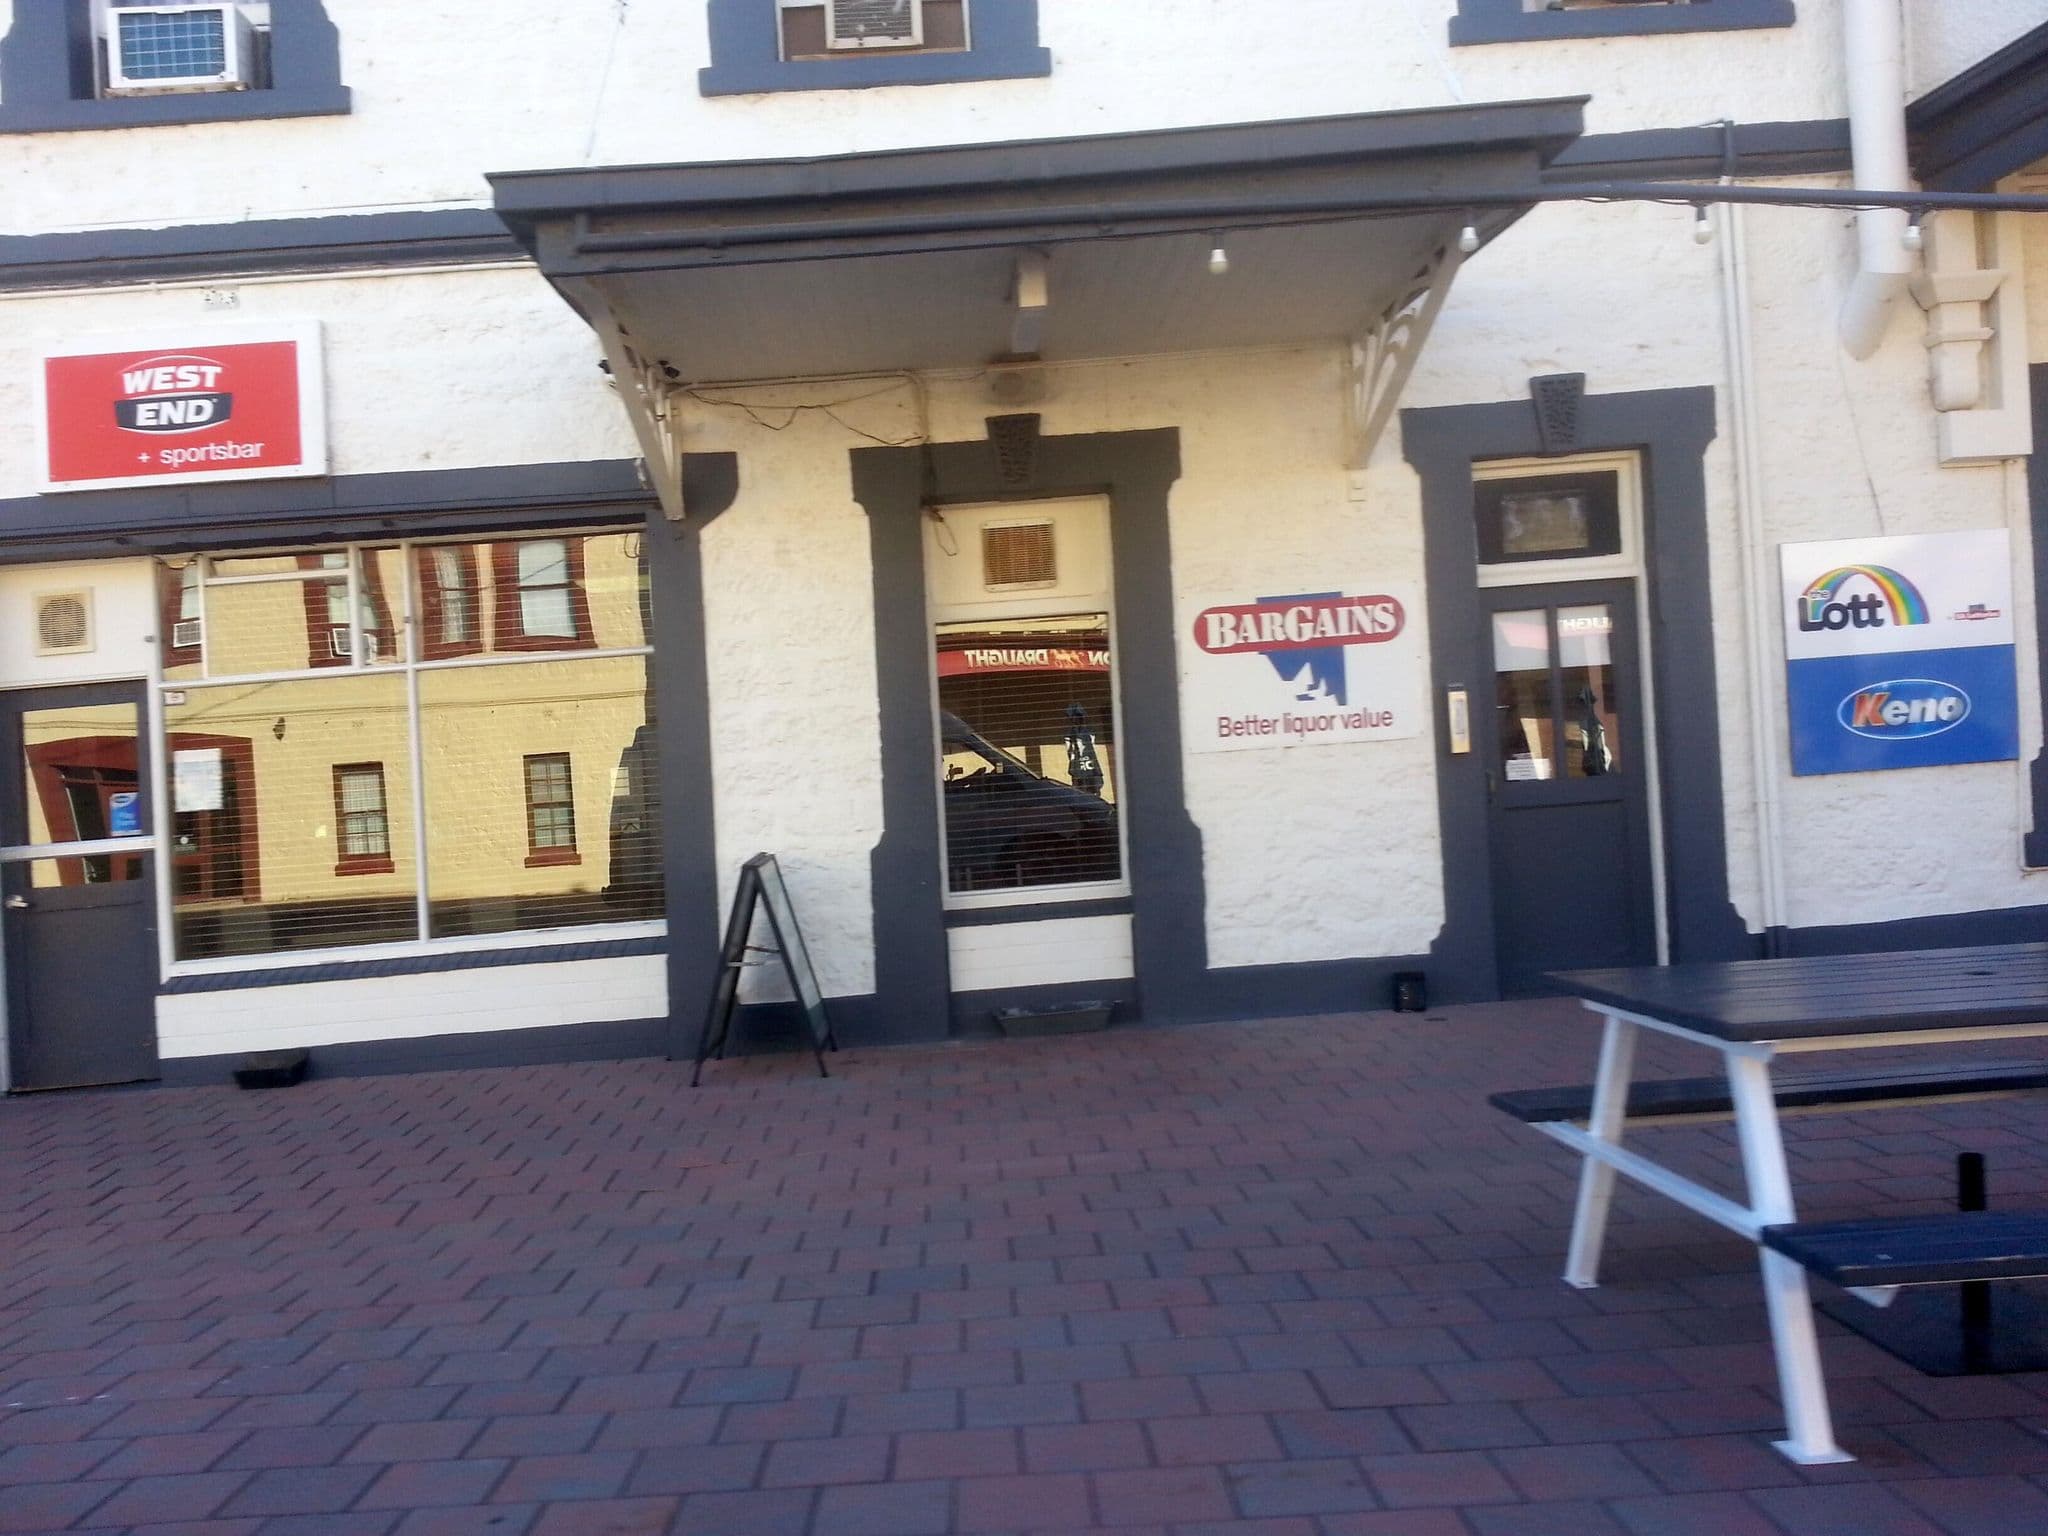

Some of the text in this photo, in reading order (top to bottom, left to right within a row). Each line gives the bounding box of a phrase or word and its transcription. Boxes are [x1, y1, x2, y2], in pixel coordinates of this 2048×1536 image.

[122, 365, 223, 394] WEST
[136, 399, 214, 426] END
[160, 441, 264, 468] sportsbar
[1204, 603, 1397, 648] BARGAINS
[1798, 593, 1885, 632] Lott
[1217, 707, 1394, 738] Better liquor value
[1852, 692, 1964, 728] Keno
